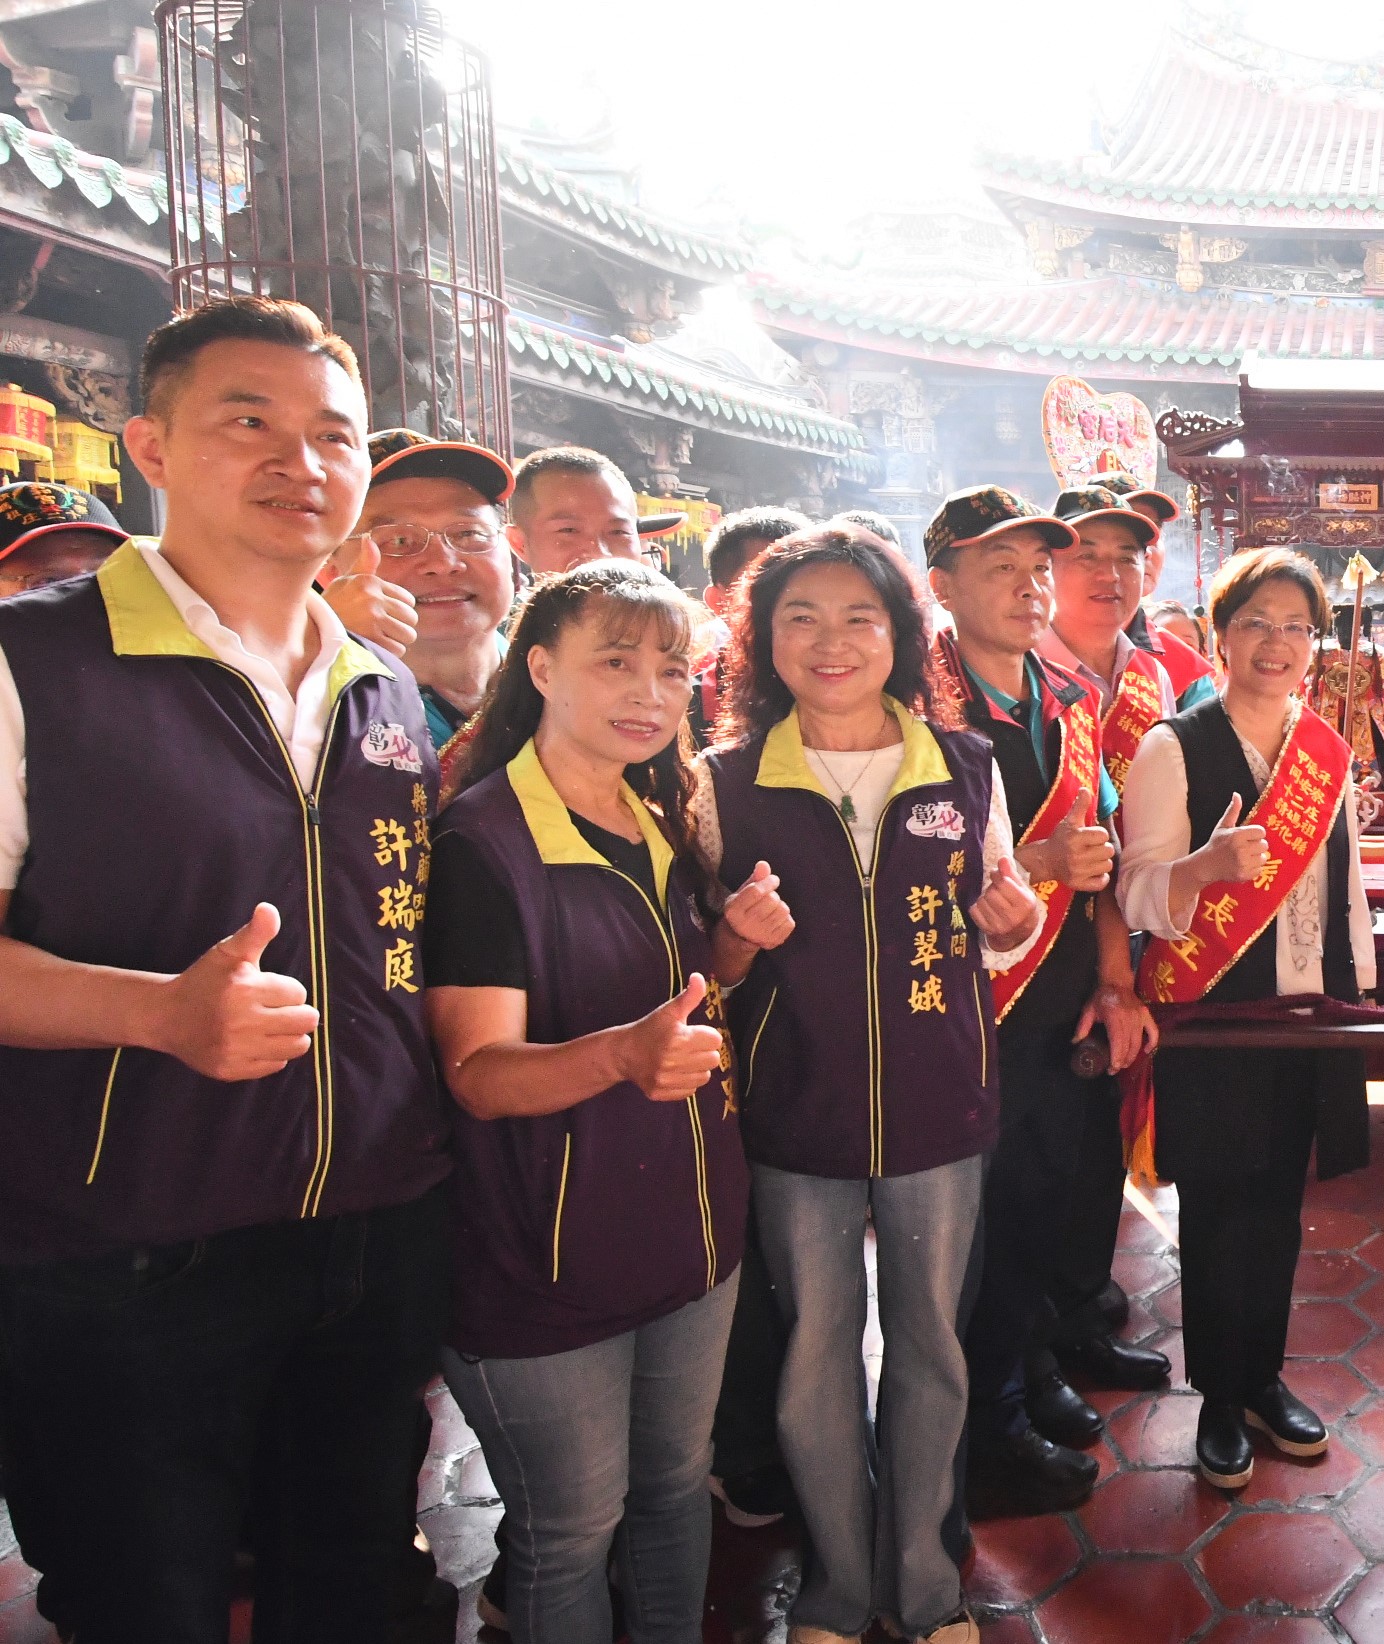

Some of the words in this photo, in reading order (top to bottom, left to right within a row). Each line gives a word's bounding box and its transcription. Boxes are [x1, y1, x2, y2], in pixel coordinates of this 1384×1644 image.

[1288, 763, 1326, 805] 同安寮
[1297, 747, 1333, 787] 甲辰年
[1274, 797, 1317, 839] 請媽祖
[1283, 783, 1321, 823] 十二庄
[1266, 814, 1309, 857] 彰化縣
[369, 818, 420, 994] 許瑞庭
[906, 884, 947, 1015] 許翠娥
